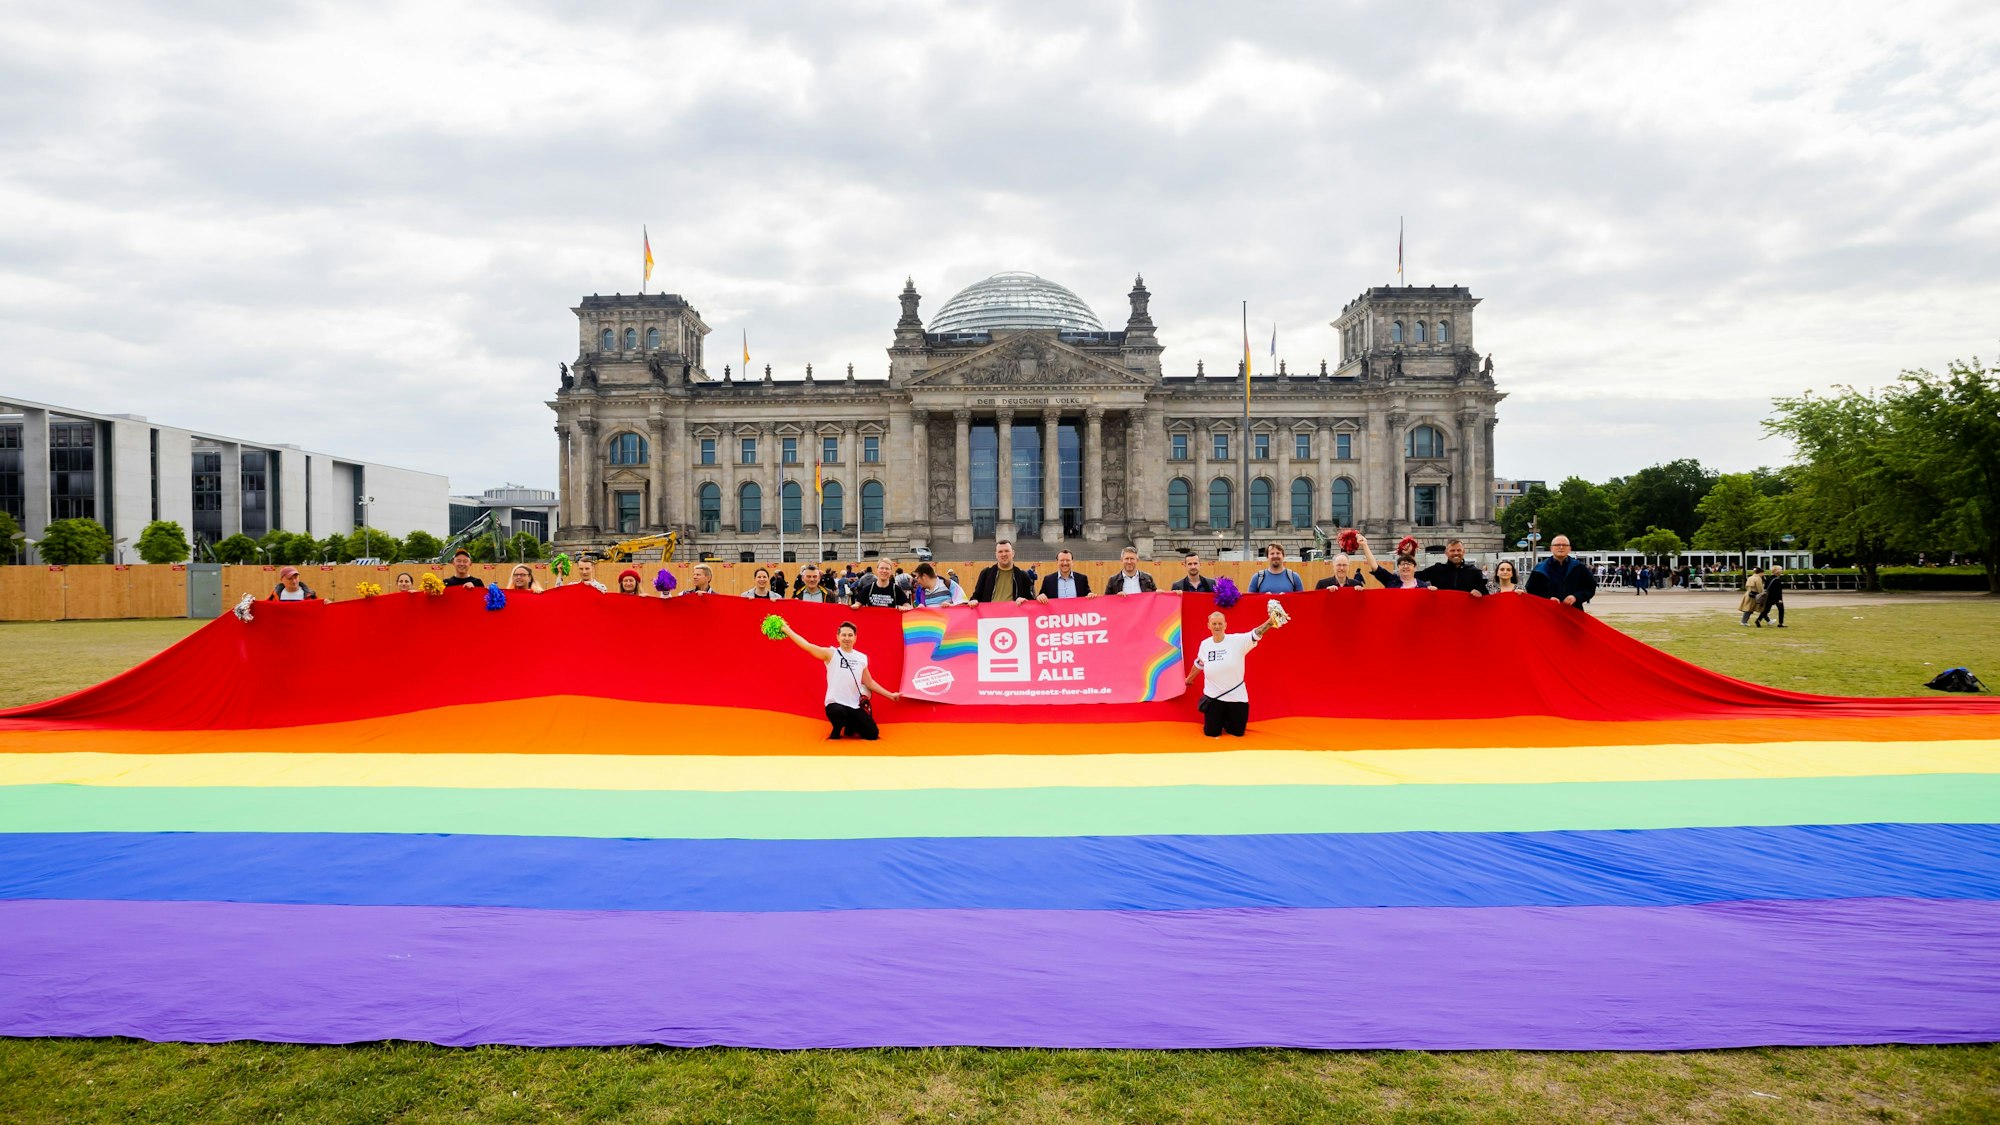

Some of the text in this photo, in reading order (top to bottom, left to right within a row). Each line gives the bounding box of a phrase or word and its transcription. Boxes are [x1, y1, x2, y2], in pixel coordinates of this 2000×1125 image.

[1035, 612, 1107, 629] GRUND-
[1036, 629, 1108, 646] GESETZ
[1037, 646, 1075, 665] FÜR
[1037, 667, 1085, 682] ALLE
[978, 687, 1112, 697] www.grundgesetz-fuer-alle.de
